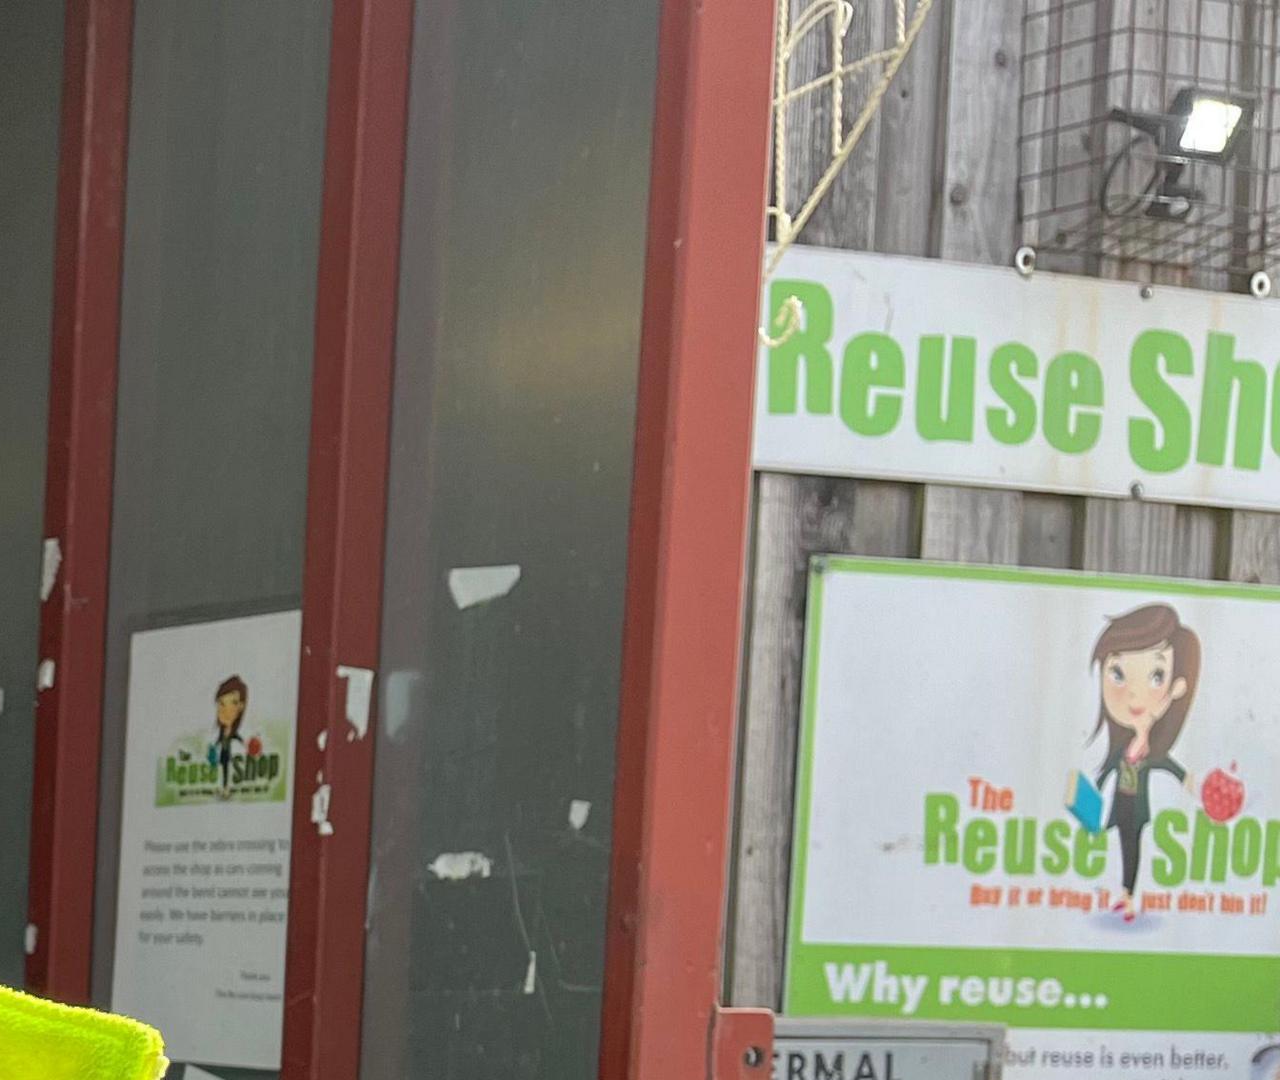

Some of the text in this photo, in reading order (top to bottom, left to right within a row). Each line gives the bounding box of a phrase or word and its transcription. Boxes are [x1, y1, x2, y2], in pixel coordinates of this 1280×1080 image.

[768, 279, 1280, 473] Reuse Sh
[232, 753, 279, 784] Shop
[968, 776, 1015, 812] The
[924, 791, 1108, 878] Reuse
[970, 883, 1002, 907] Buy
[1008, 886, 1021, 907] it
[1049, 887, 1092, 913] bring
[1098, 889, 1111, 910] it
[1141, 892, 1172, 913] just
[1177, 892, 1214, 913] don't
[824, 961, 1109, 1013] Why reuse...
[1042, 1050, 1095, 1067] reuse
[1100, 1045, 1114, 1066] is
[1120, 1051, 1164, 1069] even
[1170, 1045, 1230, 1071] better.
